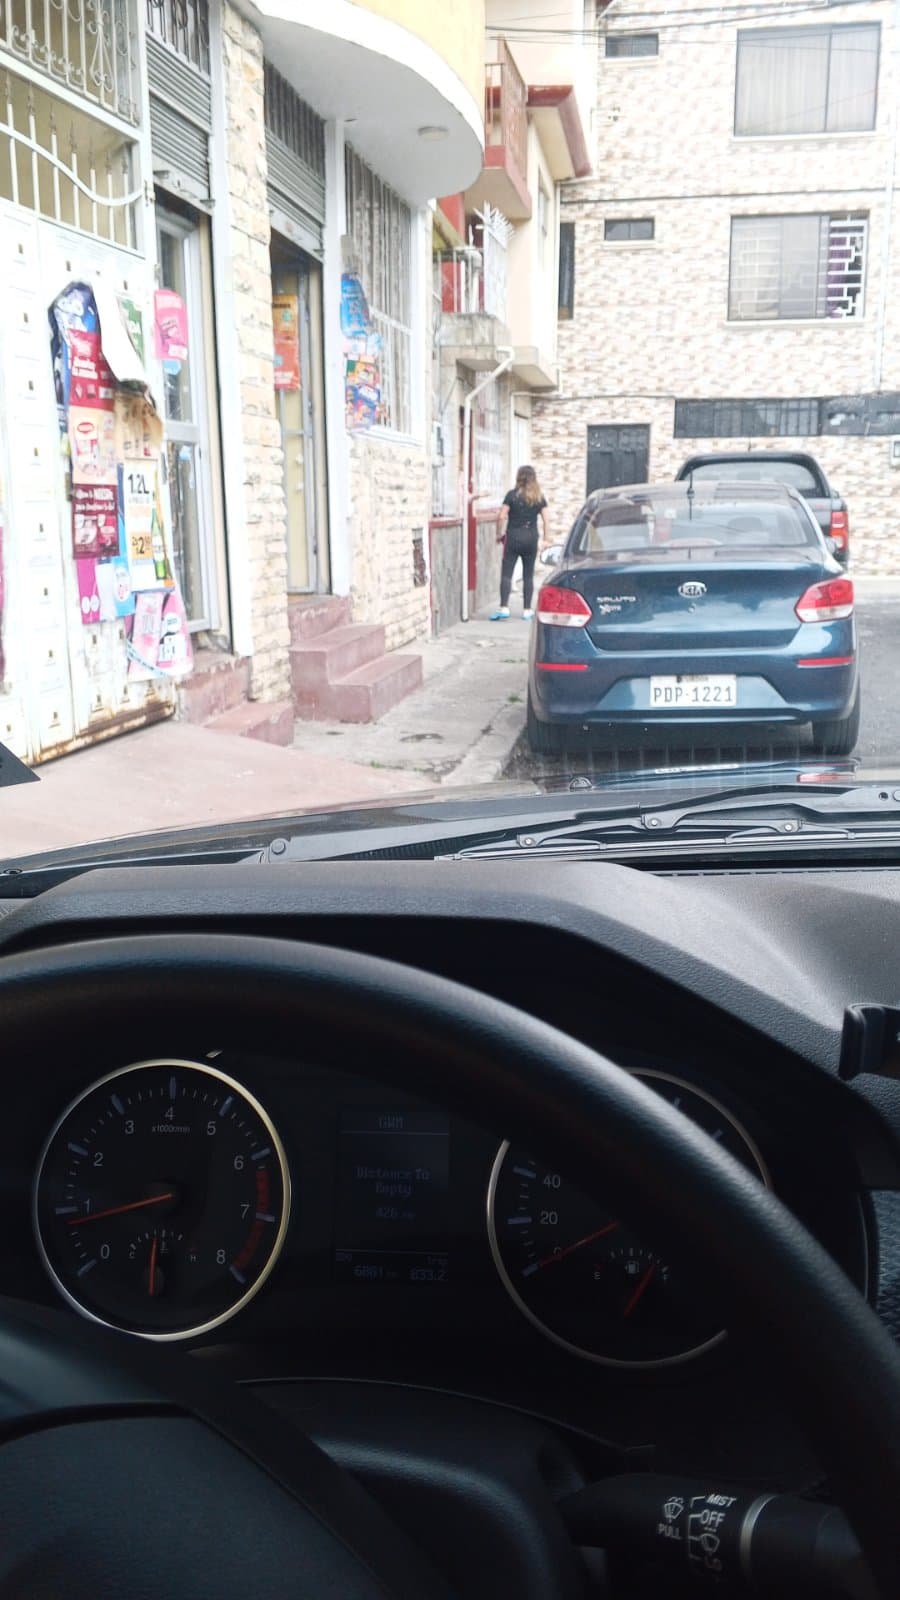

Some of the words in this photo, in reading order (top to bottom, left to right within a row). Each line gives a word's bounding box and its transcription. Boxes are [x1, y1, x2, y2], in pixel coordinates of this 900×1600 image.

[678, 582, 706, 598] KIA
[653, 685, 733, 703] PDP-1221
[164, 1106, 175, 1121] 4
[124, 1120, 135, 1135] 3
[206, 1121, 217, 1136] 5
[93, 1152, 104, 1167] 2
[233, 1155, 244, 1170] 6
[543, 1174, 561, 1189] 40
[84, 1198, 91, 1213] 1
[240, 1204, 250, 1220] 7
[540, 1211, 558, 1225] 20
[100, 1244, 110, 1260] 0
[216, 1249, 226, 1264] 8
[706, 1493, 737, 1508] MIST
[700, 1508, 726, 1528] OFF
[657, 1523, 682, 1540] PULL
